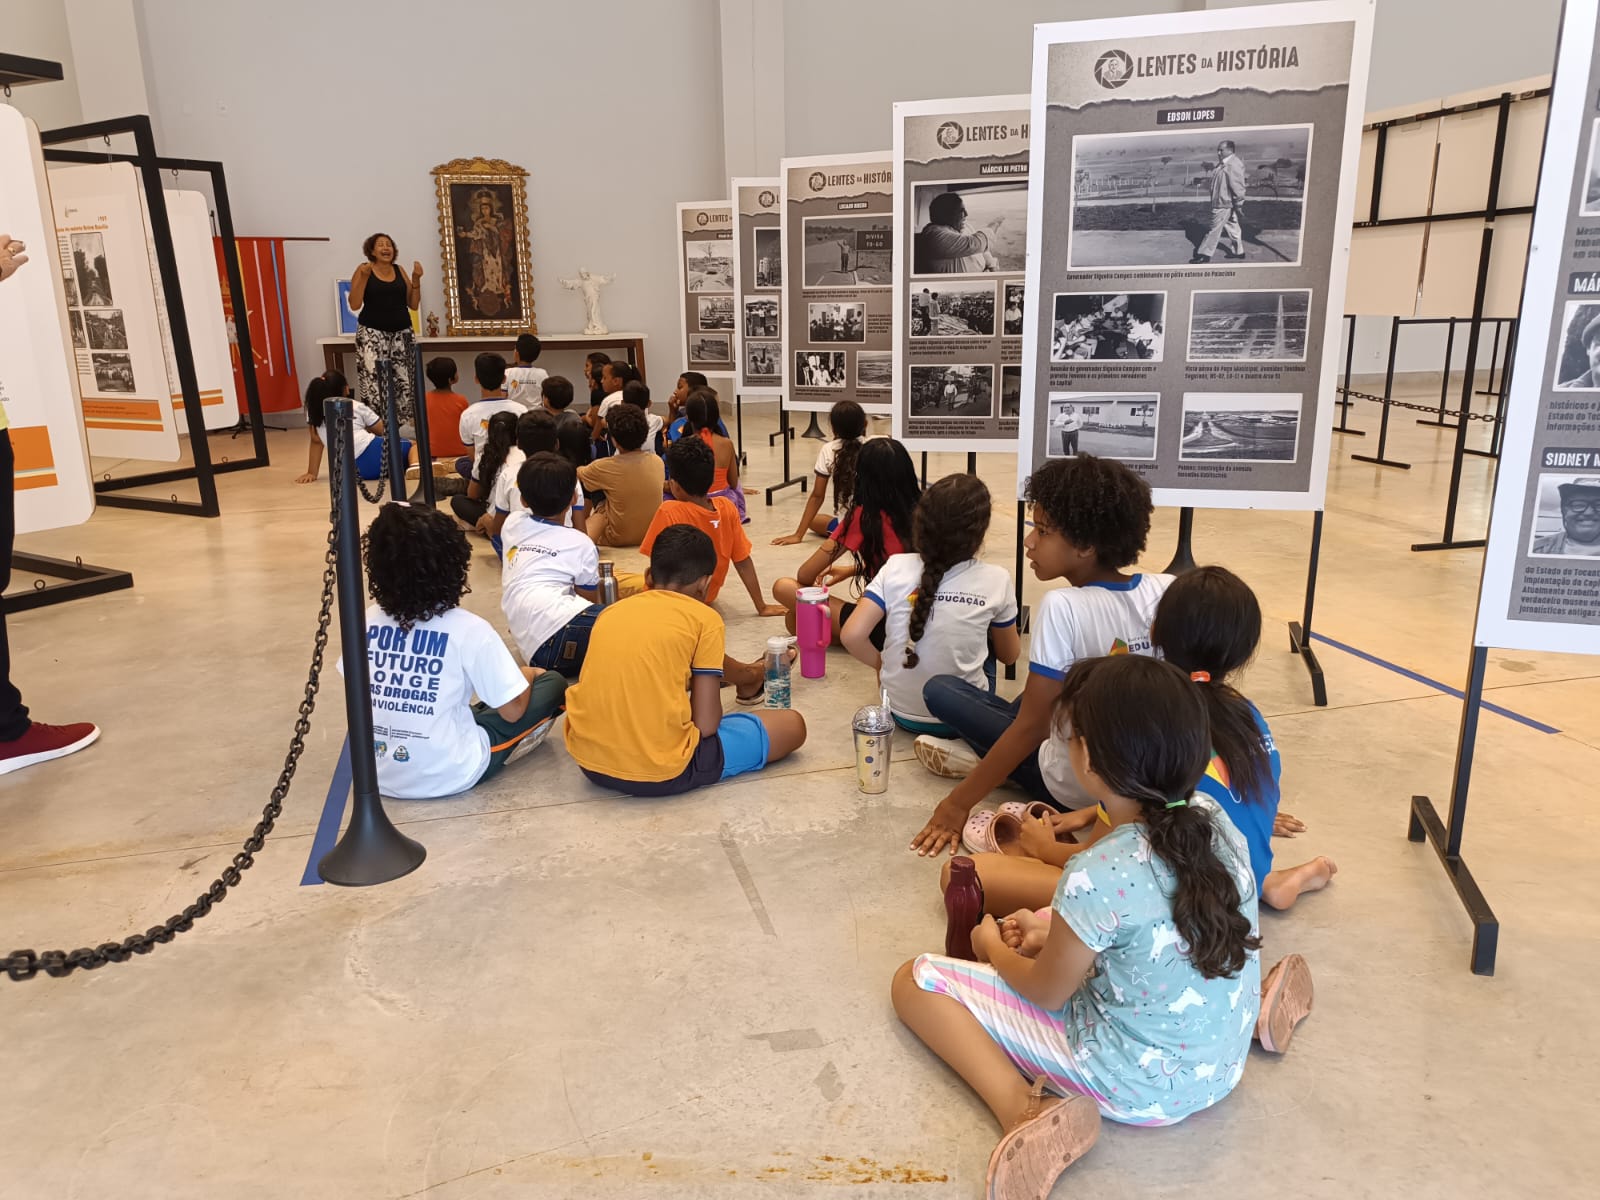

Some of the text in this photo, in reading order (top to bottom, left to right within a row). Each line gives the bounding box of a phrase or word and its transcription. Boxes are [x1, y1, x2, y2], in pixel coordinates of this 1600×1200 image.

[1136, 44, 1300, 78] LENTES DA HISTÓRIA
[1167, 109, 1215, 122] EDSON LOPES
[966, 125, 1008, 142] LENTES
[1010, 128, 1019, 136] DA
[981, 163, 1003, 174] MÁRCIO
[827, 174, 856, 187] LENTES
[1549, 400, 1590, 410] históricos
[1547, 412, 1575, 421] Estado
[1575, 412, 1587, 421] do
[1545, 452, 1592, 467] SIDNEY
[1535, 566, 1562, 575] Estado
[1521, 586, 1566, 595] Atualmente
[1520, 596, 1561, 605] verdadeiro
[1562, 598, 1589, 606] museu
[366, 625, 450, 658] POR UM
[1128, 641, 1153, 653] EDU
[373, 670, 441, 691] ONGE
[383, 686, 438, 703] DROGAS
[377, 699, 435, 716] VIOLÊNCIA
